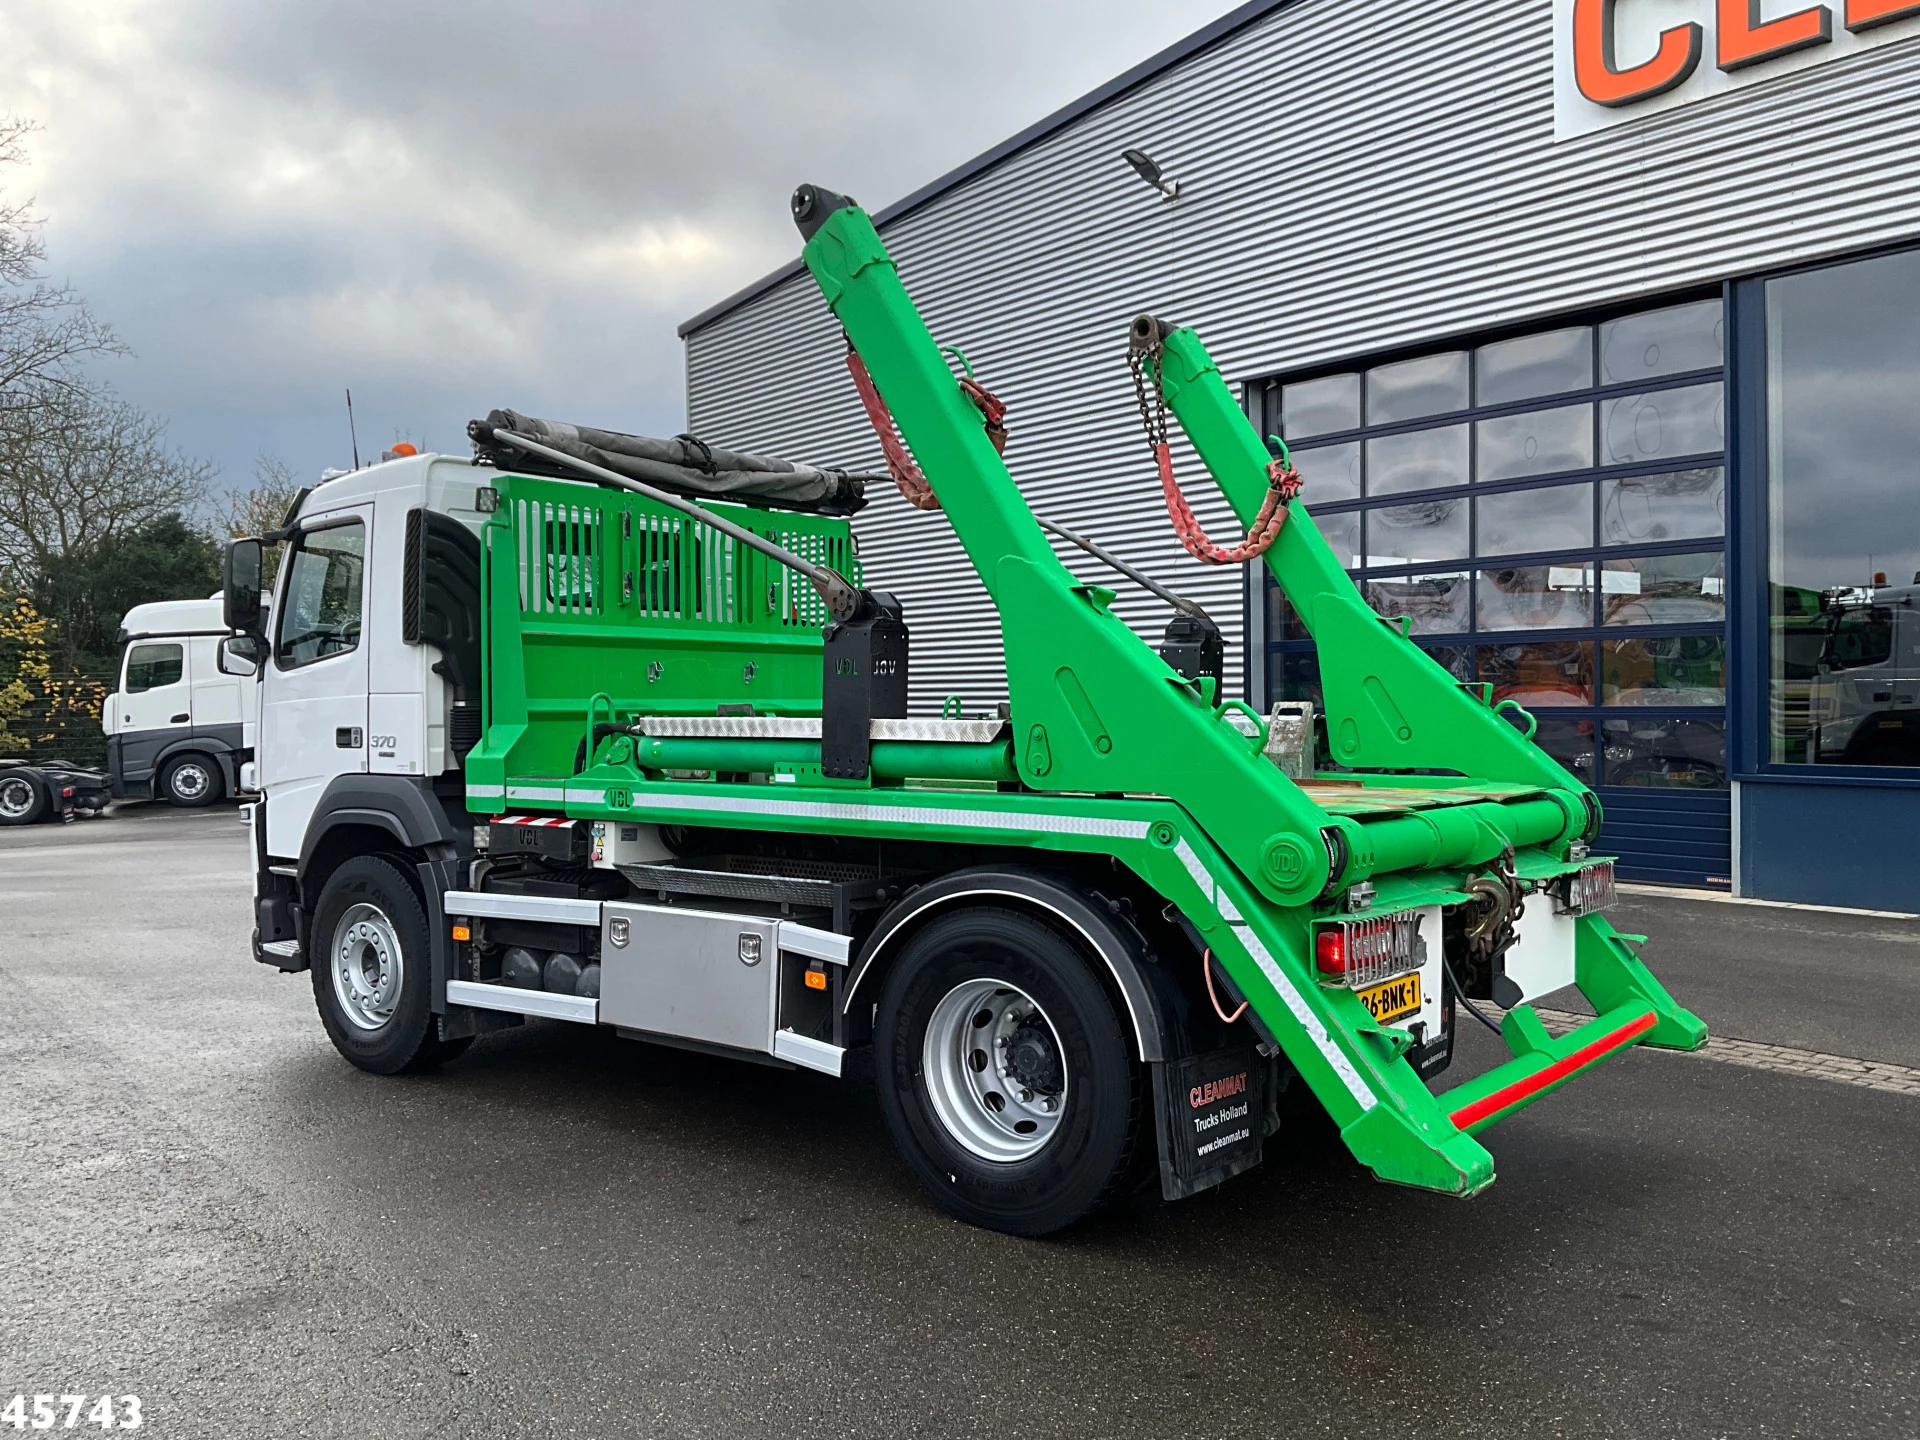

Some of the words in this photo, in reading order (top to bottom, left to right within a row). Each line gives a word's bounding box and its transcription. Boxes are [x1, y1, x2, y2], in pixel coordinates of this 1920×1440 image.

[1572, 0, 1920, 107] CL
[835, 658, 858, 675] VDL
[370, 735, 397, 748] 370
[609, 790, 630, 808] VDL
[519, 828, 538, 846] VDL
[1271, 852, 1299, 873] VDL
[1189, 1071, 1247, 1109] CLEANMAT
[1193, 1113, 1220, 1132] Trucks
[1219, 1101, 1248, 1122] Holland
[1197, 1128, 1250, 1157] www.cleanmat.eu
